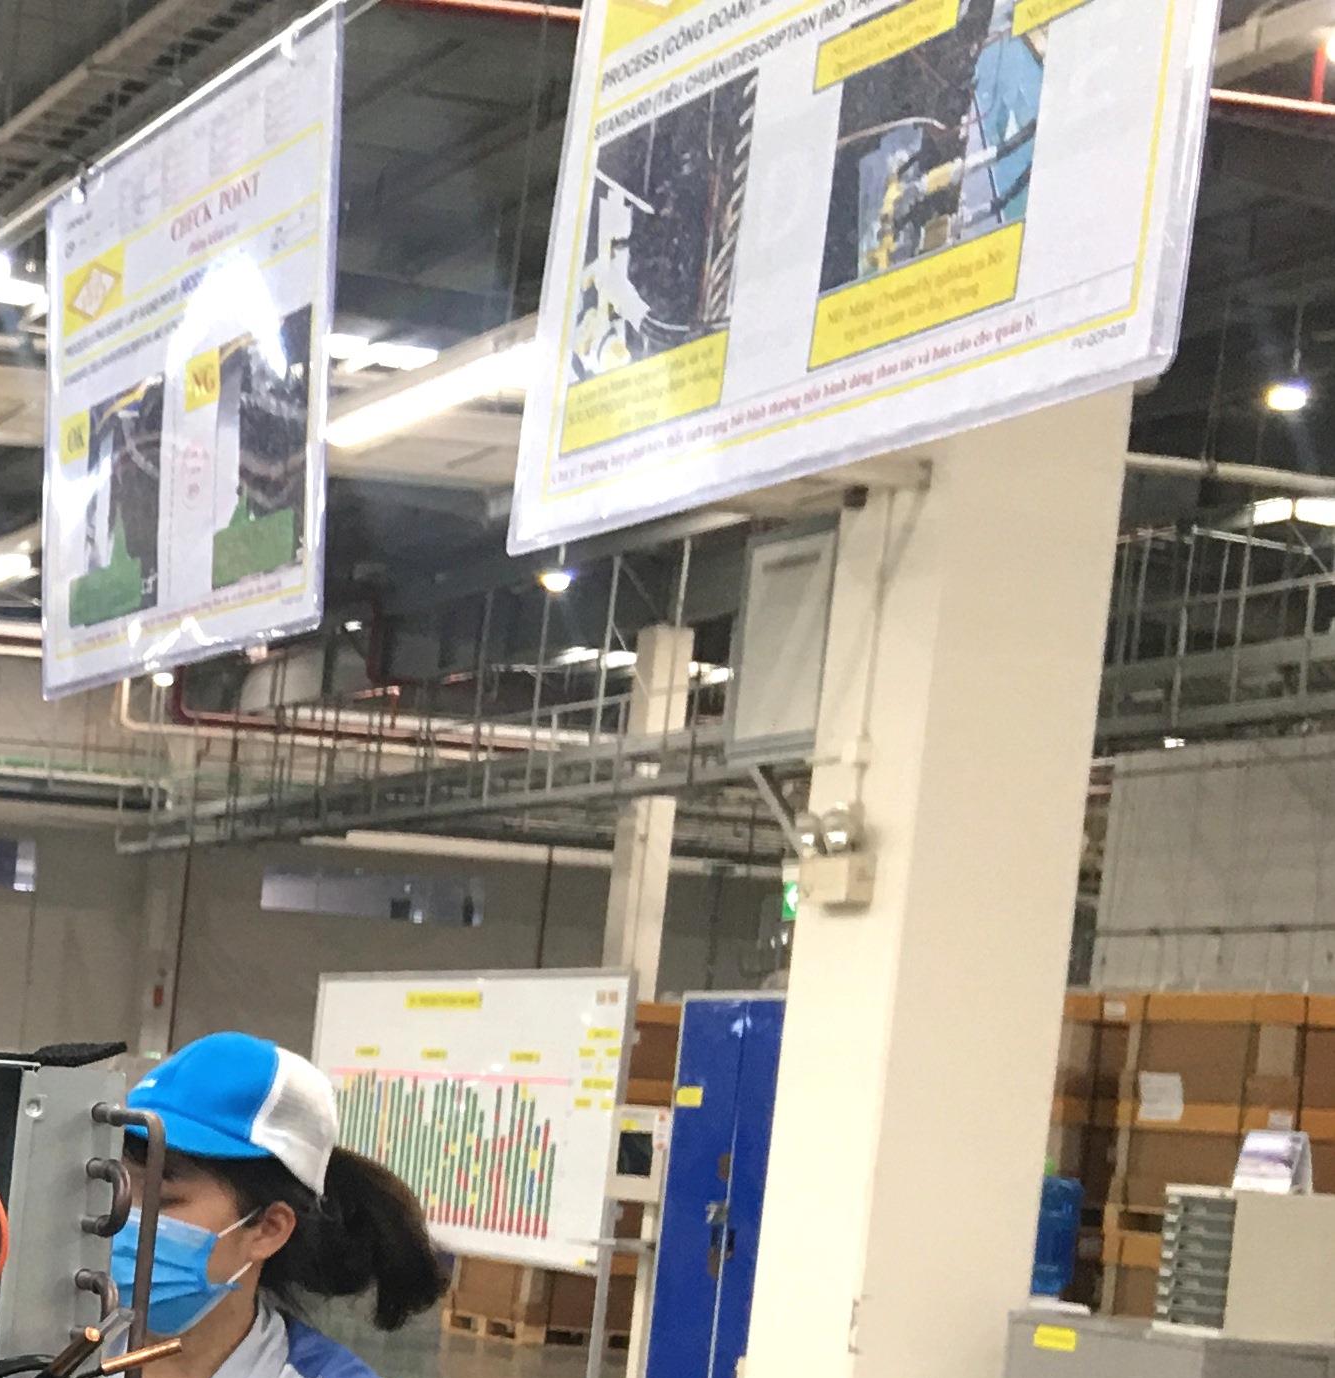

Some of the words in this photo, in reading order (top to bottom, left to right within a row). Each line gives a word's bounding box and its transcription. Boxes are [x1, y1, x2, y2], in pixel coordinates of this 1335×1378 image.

[601, 43, 660, 92] PROCESS
[594, 97, 652, 141] STANDARD
[219, 171, 261, 215] POINT
[192, 362, 217, 397] NG
[66, 424, 86, 455] OK
